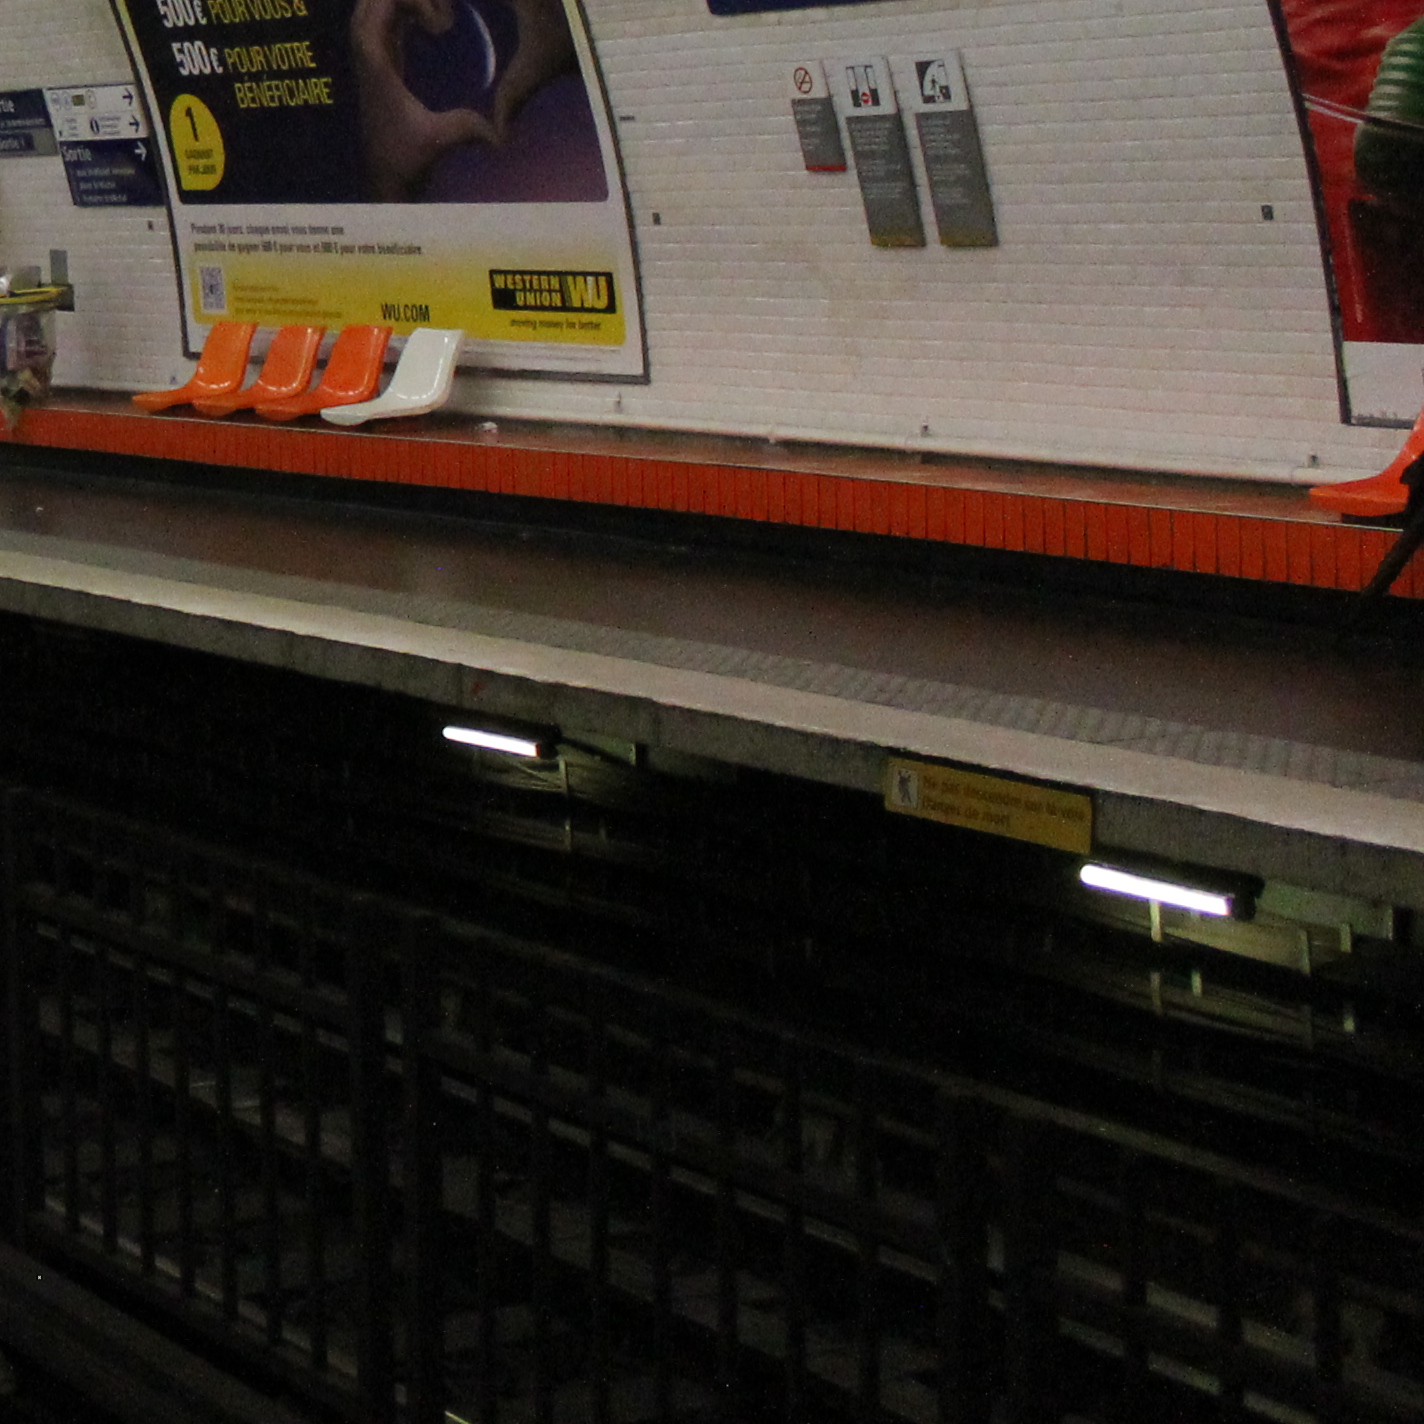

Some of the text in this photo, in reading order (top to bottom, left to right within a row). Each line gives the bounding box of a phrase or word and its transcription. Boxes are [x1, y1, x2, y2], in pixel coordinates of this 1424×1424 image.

[224, 46, 268, 73] POUR
[265, 41, 318, 71] VOTRE
[234, 74, 335, 109] BÉNÉFICIAIRE
[184, 106, 200, 143] 1
[61, 145, 93, 162] Sortie
[493, 273, 610, 309] WESTERN WU
[515, 290, 563, 307] UNION
[381, 303, 431, 323] WU.COM
